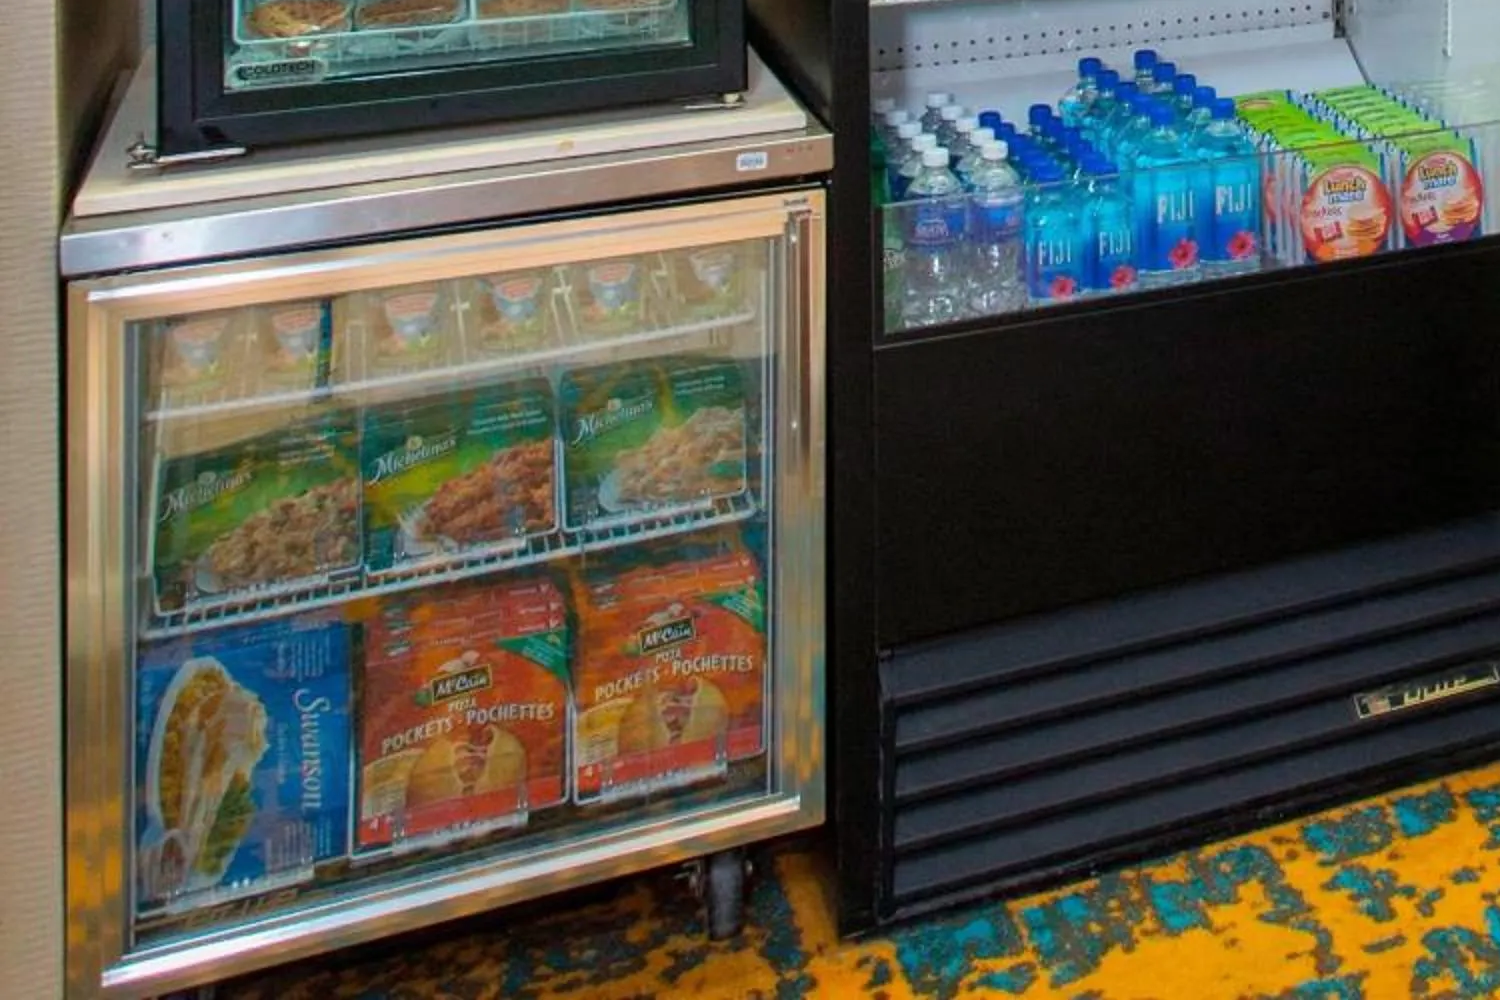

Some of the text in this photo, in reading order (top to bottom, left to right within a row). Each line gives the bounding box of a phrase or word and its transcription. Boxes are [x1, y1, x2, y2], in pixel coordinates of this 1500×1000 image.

[1156, 190, 1194, 225] FIJI
[1215, 183, 1252, 216] FIJI
[1038, 238, 1072, 266] FIJI
[1099, 231, 1132, 257] FIJI
[643, 624, 692, 648] McCain
[671, 654, 753, 677] POCHETTES
[381, 702, 555, 755] POCKETS POCHETTES
[292, 687, 332, 811] Swanson
